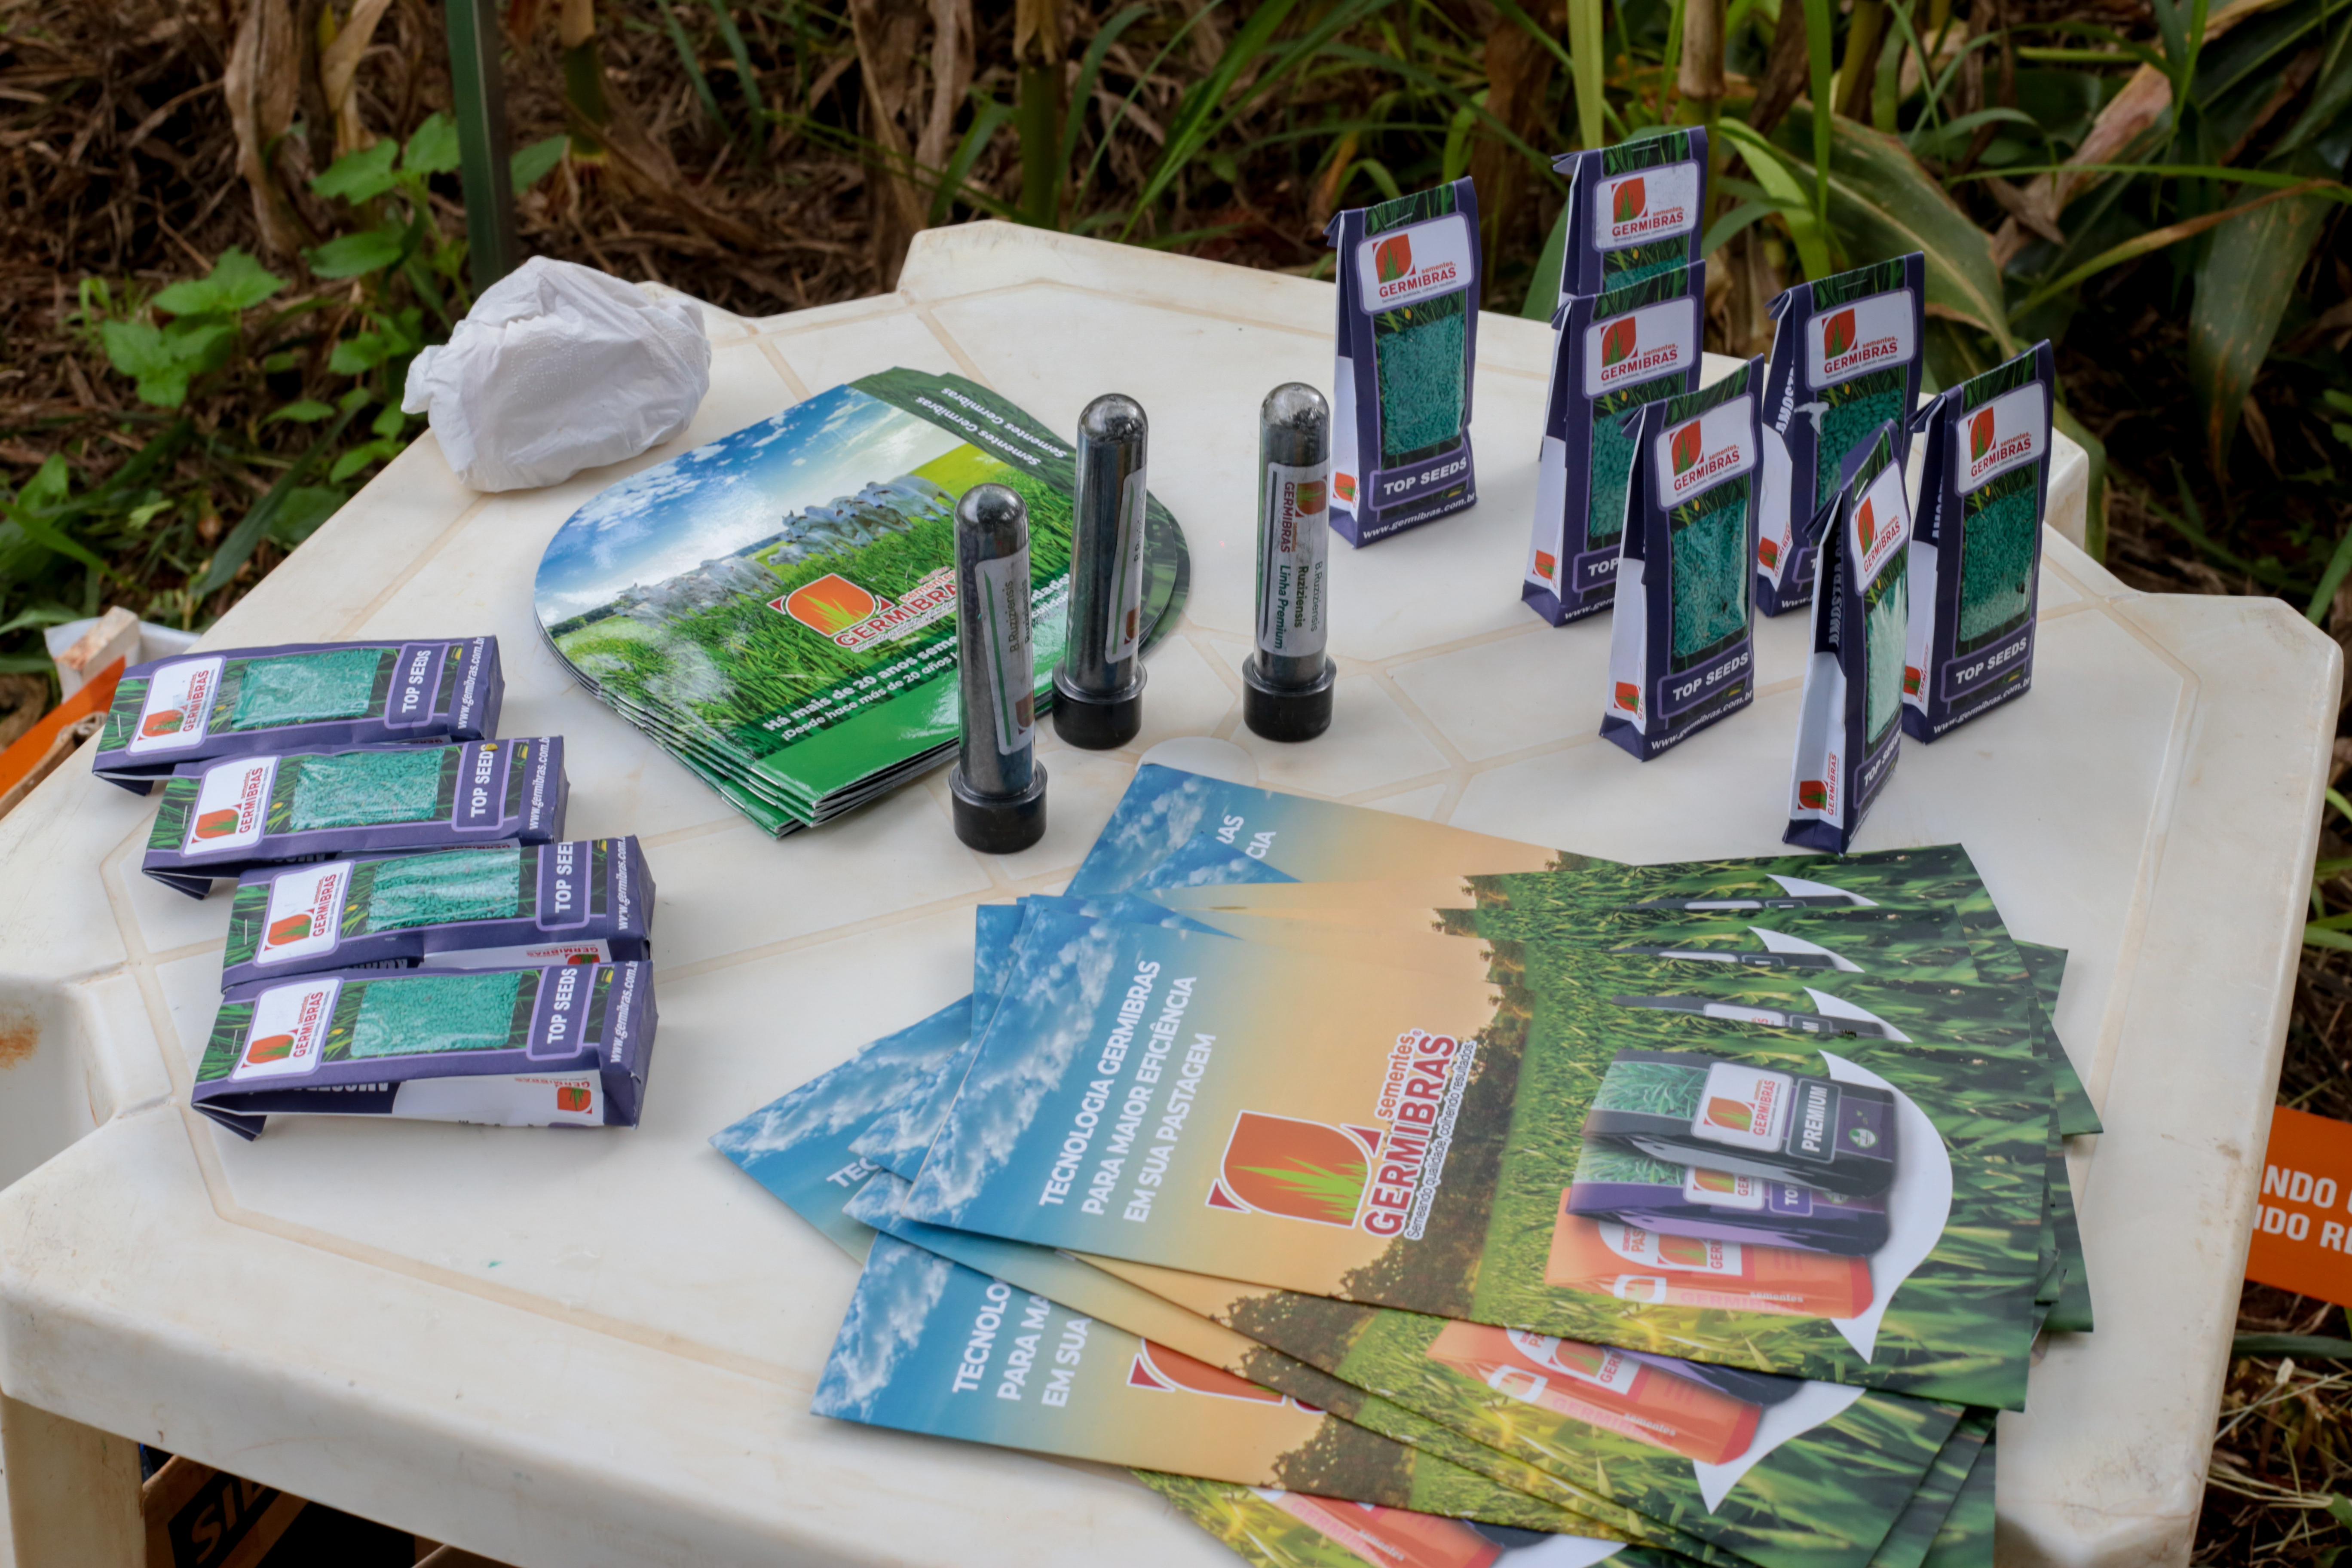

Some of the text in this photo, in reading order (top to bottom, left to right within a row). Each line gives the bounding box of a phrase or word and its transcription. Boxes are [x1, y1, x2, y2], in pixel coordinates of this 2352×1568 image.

[1612, 212, 1683, 236] GERMIBRAS
[1379, 267, 1456, 297] GERMIBRAS
[1601, 350, 1677, 381] GERMIBRAS
[1824, 342, 1897, 374] GERMIBRAS
[915, 396, 1041, 466] Sementes Germibras
[941, 388, 1067, 458] Sementes Germibras
[1384, 457, 1466, 495] TOP SEEDS
[1674, 451, 1740, 491] GERMIBRAS
[1971, 438, 2031, 477] GERMIBRAS
[1280, 481, 1295, 553] GERMIBRAS
[1363, 492, 1475, 539] www.germibras.com.br
[1864, 521, 1900, 572] GERMIBRAS
[1294, 565, 1308, 628] Ruziziensis
[1311, 561, 1323, 632] B.Ruziziensis
[1588, 558, 1619, 576] TOP
[835, 583, 956, 647] GERMIBRA
[1002, 580, 1020, 652] B.Ruziziensis
[1275, 564, 1291, 649] Linha Premium
[402, 650, 431, 713] TOP SEEDS
[458, 637, 485, 729] www.germibras.com.br
[824, 701, 858, 719] hace
[858, 688, 887, 704] más
[887, 680, 904, 690] de
[903, 671, 920, 683] 20
[922, 656, 952, 674] años
[1673, 677, 1702, 701] TOP
[1706, 652, 1748, 685] SEEDS
[1956, 637, 2026, 684] TOP SEEDS
[183, 670, 209, 732] GERMIBRAS
[763, 715, 791, 731] Há
[790, 697, 832, 719] mais
[832, 687, 855, 700] de
[853, 676, 877, 689] 20
[877, 657, 918, 679] anos
[1651, 689, 1752, 750] www.germibras.com.br
[1934, 677, 2030, 733] www.germibras.com.br
[239, 767, 263, 833] GERMIBRAS
[471, 787, 488, 818] TOP
[1828, 754, 1836, 816] GERMIBRAS
[1864, 759, 1881, 787] TOP
[313, 874, 336, 937] GERMIBRAS
[555, 879, 572, 914] TOP
[293, 992, 323, 1057] GERMIBRAS
[547, 968, 578, 1044] TOP SEEDS
[1038, 961, 1161, 1206] TECNOLOGIA GERMIBRAS
[1081, 977, 1197, 1215] PARA MAIOR EFICIÊNCIA
[1378, 1035, 1415, 1118] sementes
[1753, 1080, 1775, 1136] GERMIBRAS
[1123, 1033, 1216, 1222] EM SUA PASTAGEM
[1364, 1035, 1455, 1235] GERMIBRAS
[1801, 1085, 1827, 1152] PREMIUM
[1408, 1187, 1432, 1238] Semeando
[1426, 1138, 1449, 1186] qualidade,
[1440, 1093, 1460, 1136] colhendo
[1750, 1291, 1803, 1302] sementes
[997, 1334, 1041, 1400] PARA
[1041, 1318, 1092, 1407] EM SUA
